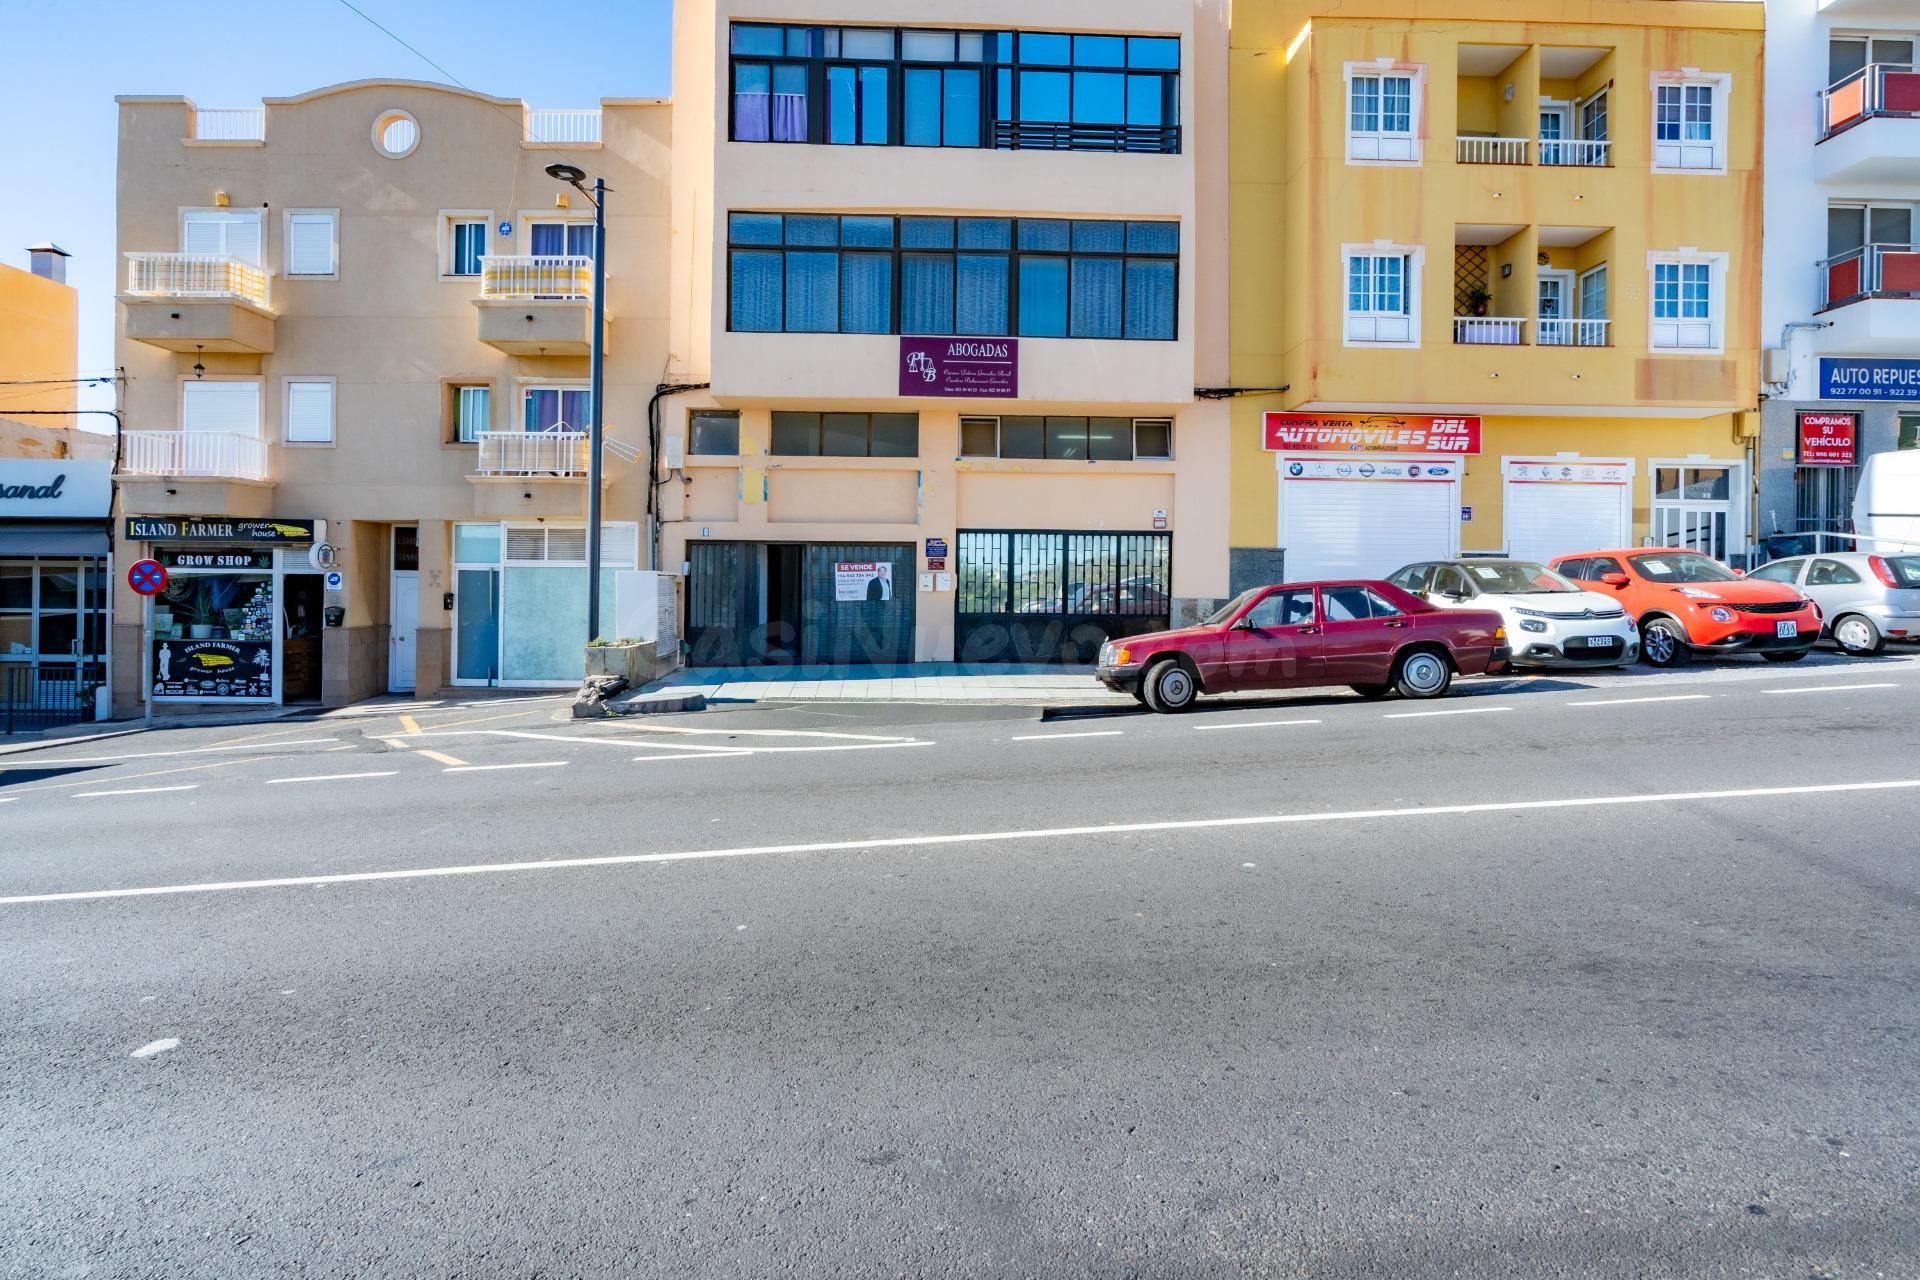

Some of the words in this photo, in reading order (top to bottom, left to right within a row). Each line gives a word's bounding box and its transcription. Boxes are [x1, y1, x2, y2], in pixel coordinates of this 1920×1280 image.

[947, 343, 1008, 357] ABOGADAS
[1831, 368, 1869, 384] AUTO
[1431, 419, 1469, 433] DEL
[1804, 417, 1851, 425] COMPRAMOS
[1822, 426, 1833, 434] SU
[1426, 436, 1469, 450] SUR
[1804, 435, 1851, 446] VEHÍCULO
[130, 522, 176, 536] ISLAND
[182, 522, 233, 536] FARMER
[238, 522, 268, 531] grower
[177, 555, 214, 565] GROW
[218, 556, 251, 566] SHOP
[184, 642, 211, 653] ISLAND
[212, 642, 240, 654] FARMER
